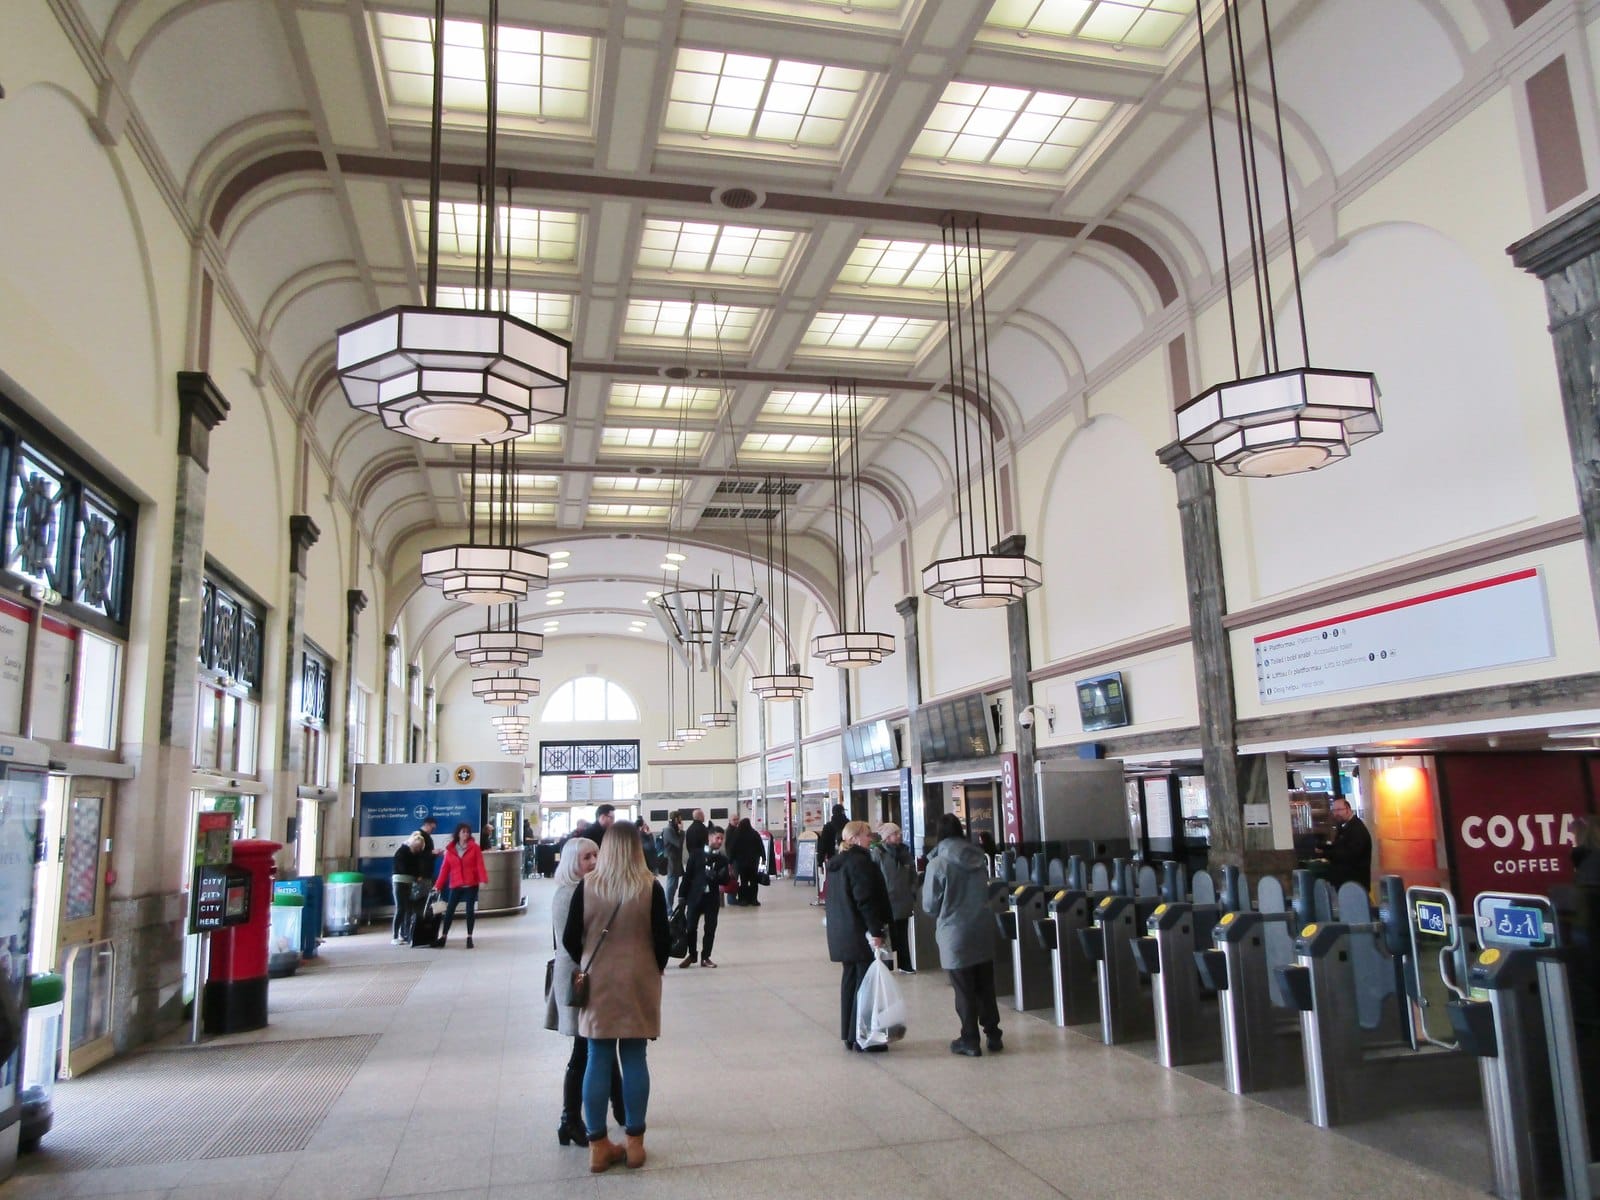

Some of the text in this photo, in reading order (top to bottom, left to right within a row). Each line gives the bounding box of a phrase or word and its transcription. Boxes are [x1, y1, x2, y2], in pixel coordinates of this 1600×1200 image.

[1003, 760, 1015, 825] COSTA
[1461, 813, 1577, 852] COSTA
[1493, 858, 1560, 874] COFFEE
[202, 878, 223, 886] CITY
[200, 904, 221, 912] CITY
[199, 917, 220, 926] HERE
